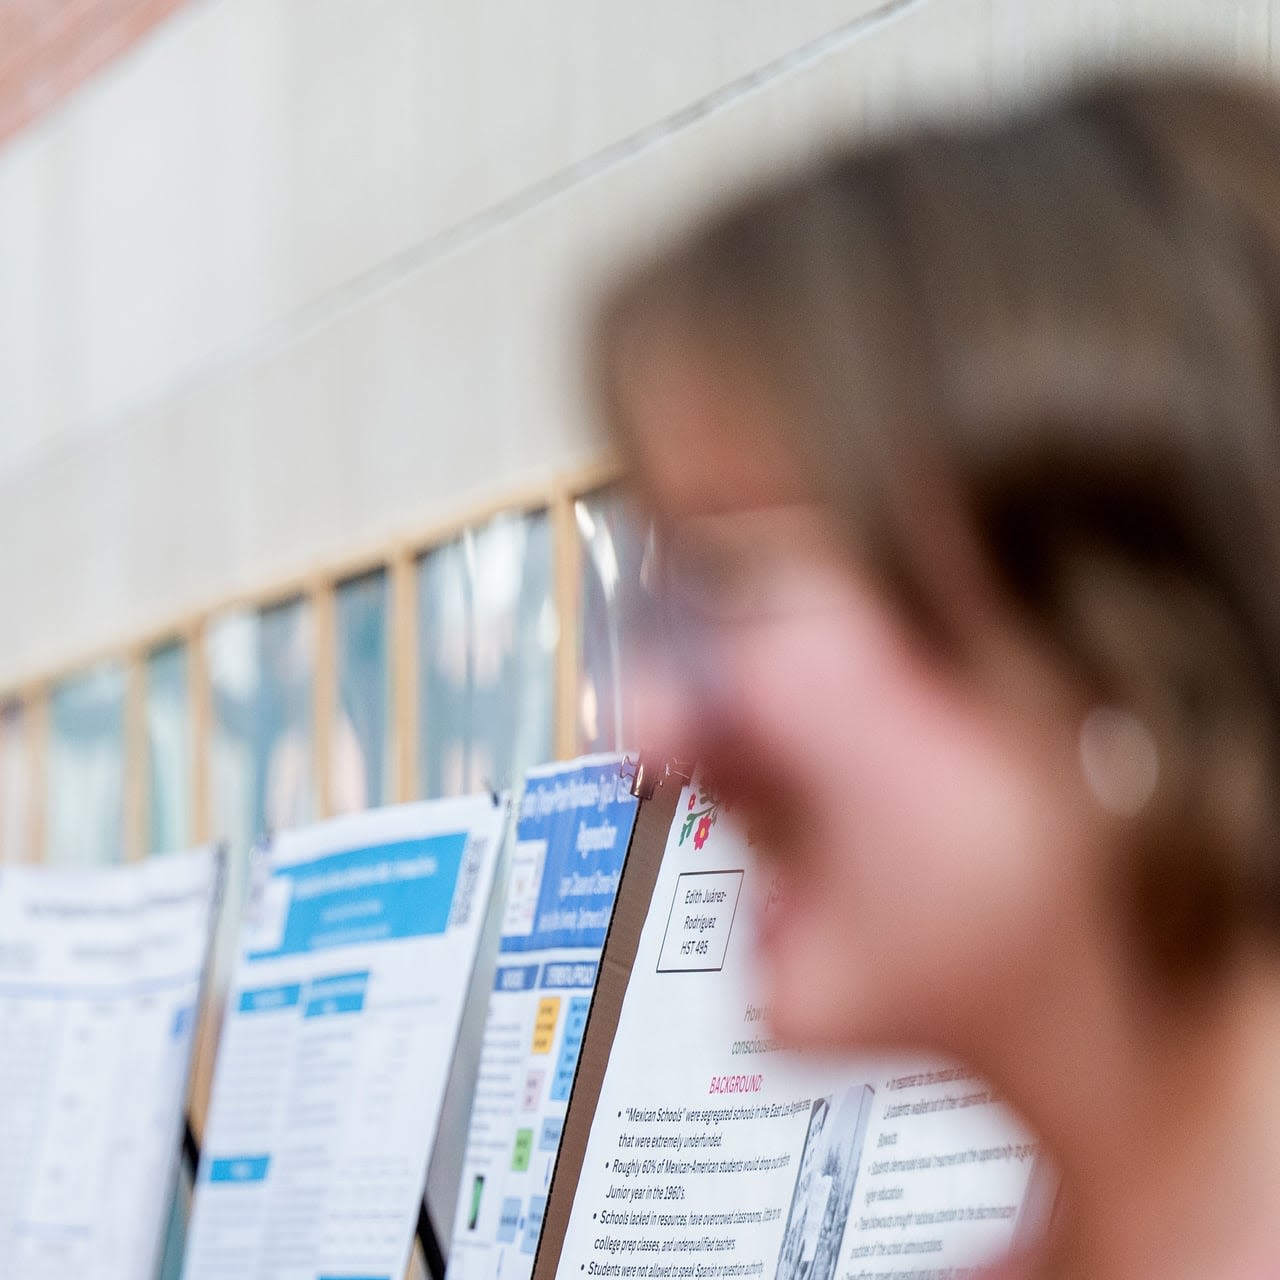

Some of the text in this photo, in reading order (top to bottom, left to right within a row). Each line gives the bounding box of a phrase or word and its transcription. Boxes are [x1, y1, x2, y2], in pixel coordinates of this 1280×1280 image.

[684, 888, 727, 904] Edith Juárez-
[684, 913, 717, 933] Rodríguez
[680, 940, 709, 955] HST 495
[744, 1003, 761, 1022] How
[685, 1110, 701, 1121] were
[700, 1108, 732, 1125] segregated
[733, 1106, 754, 1120] schools
[760, 1103, 770, 1119] the
[770, 1103, 782, 1118] East
[619, 1134, 634, 1148] that
[635, 1137, 651, 1148] were
[651, 1133, 683, 1151] extremely
[612, 1159, 640, 1177] Roughly
[641, 1159, 657, 1174] 60%
[657, 1159, 666, 1174] of
[665, 1159, 719, 1174] Mexican-American
[719, 1158, 743, 1173] students
[605, 1185, 631, 1200] Junior
[629, 1190, 646, 1203] year
[645, 1186, 652, 1199] in
[652, 1187, 664, 1200] the
[599, 1210, 703, 1226] Schools lacked in resources, have
[594, 1236, 715, 1255] college prep classes, and underqualified
[588, 1261, 621, 1277] Students
[621, 1265, 636, 1277] were
[636, 1264, 648, 1277] not
[648, 1262, 672, 1277] allowed
[678, 1263, 695, 1280] speak
[695, 1262, 717, 1280] Spanish
